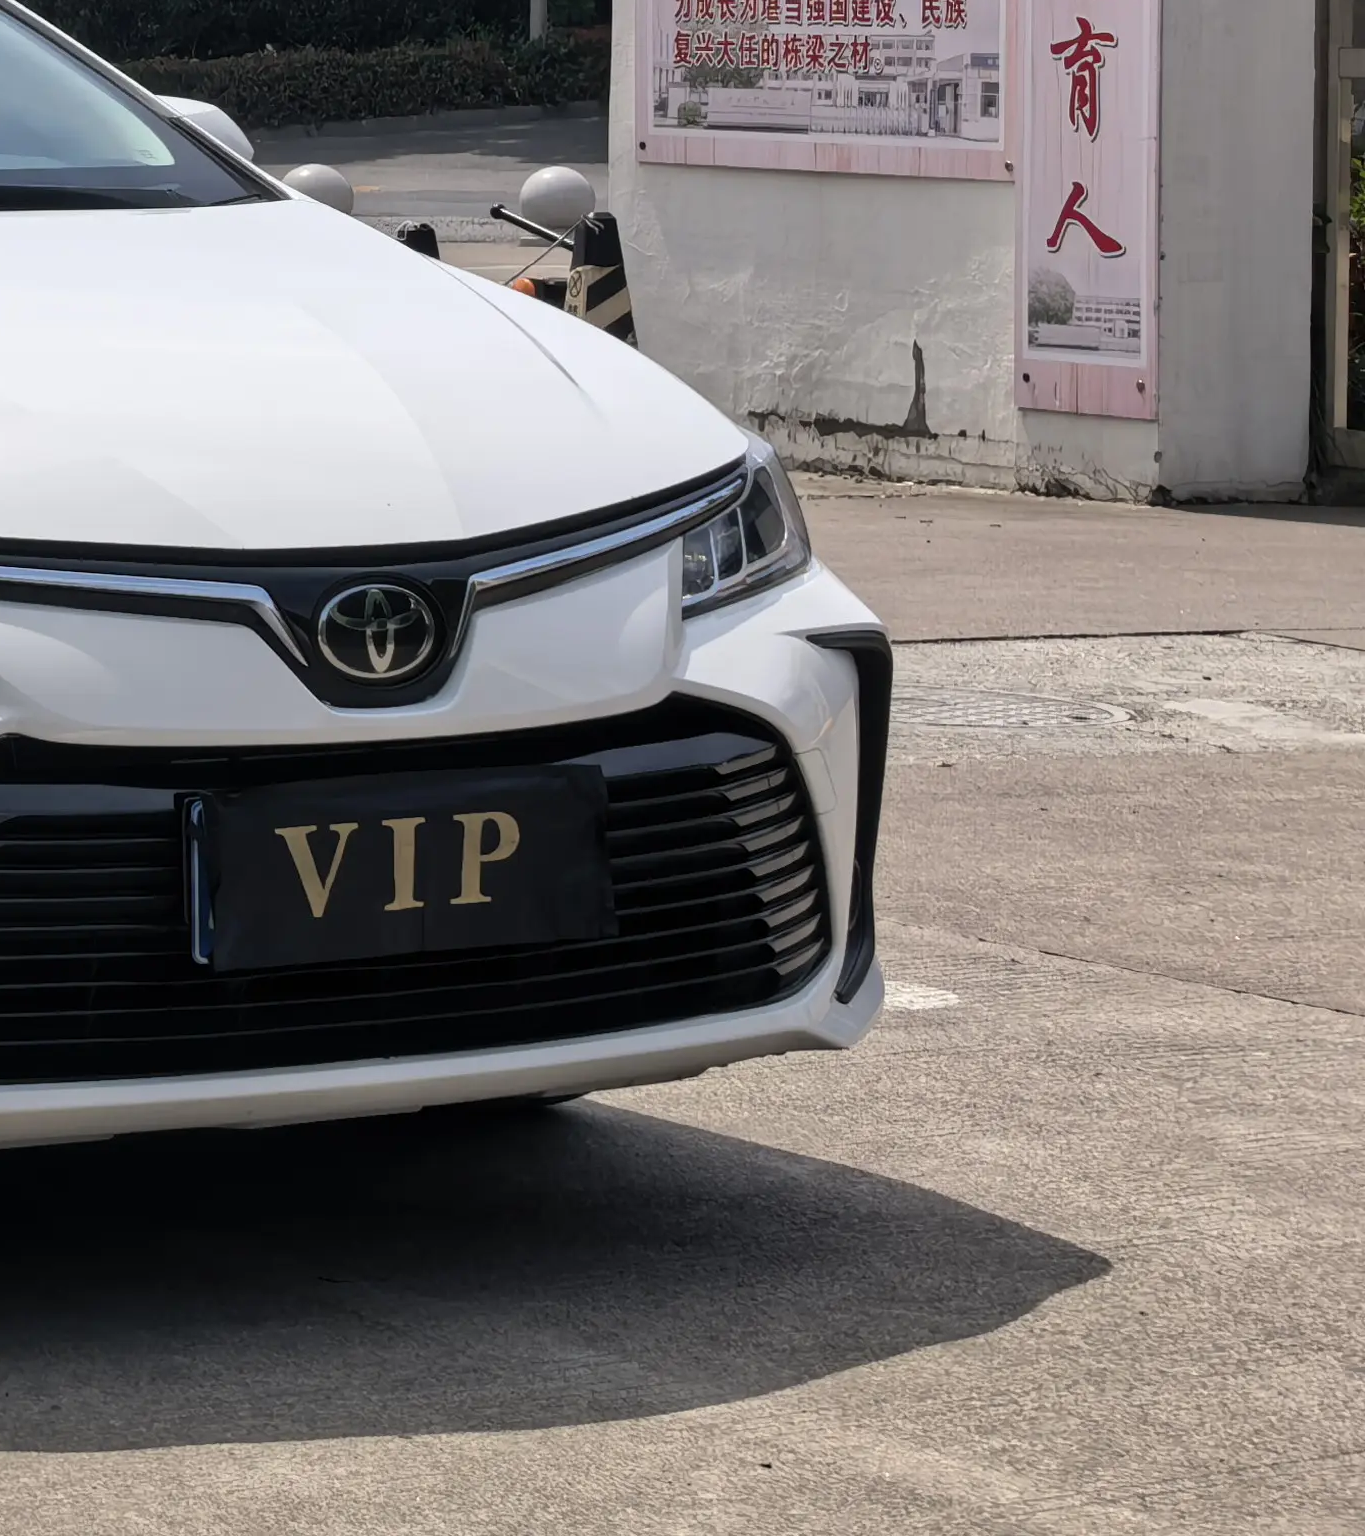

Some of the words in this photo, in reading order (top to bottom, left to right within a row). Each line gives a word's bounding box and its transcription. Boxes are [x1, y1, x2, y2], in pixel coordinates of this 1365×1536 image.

[672, 30, 884, 73] 复兴大任的栋梁之材。
[275, 810, 521, 918] VIP
